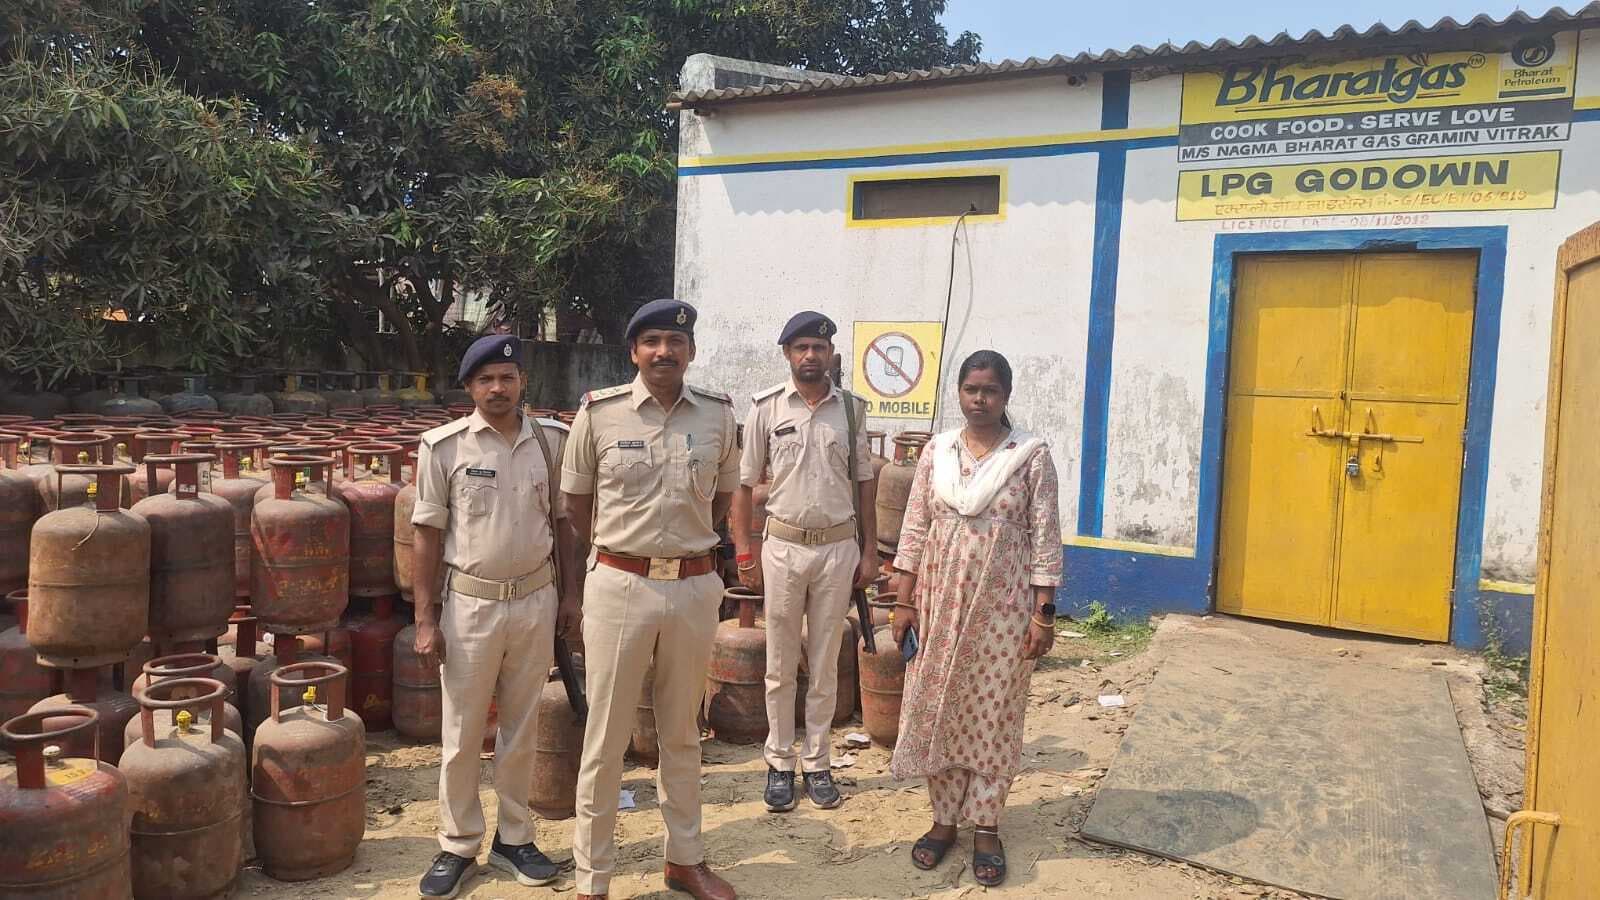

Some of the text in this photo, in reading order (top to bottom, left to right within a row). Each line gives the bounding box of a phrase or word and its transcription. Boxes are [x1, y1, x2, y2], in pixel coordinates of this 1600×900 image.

[1215, 58, 1468, 106] Bharatgas
[1504, 77, 1561, 87] Petroleum
[1513, 67, 1553, 78] Bharat
[1210, 124, 1269, 141] COOK
[1361, 111, 1440, 131] SERVE
[1451, 106, 1515, 125] LOVE
[1182, 125, 1560, 160] M/S NAGMA BHARAT GAS GRAMIN VITRAK
[1200, 159, 1510, 197] LPG GODOWN
[879, 401, 930, 415] MOBILE
